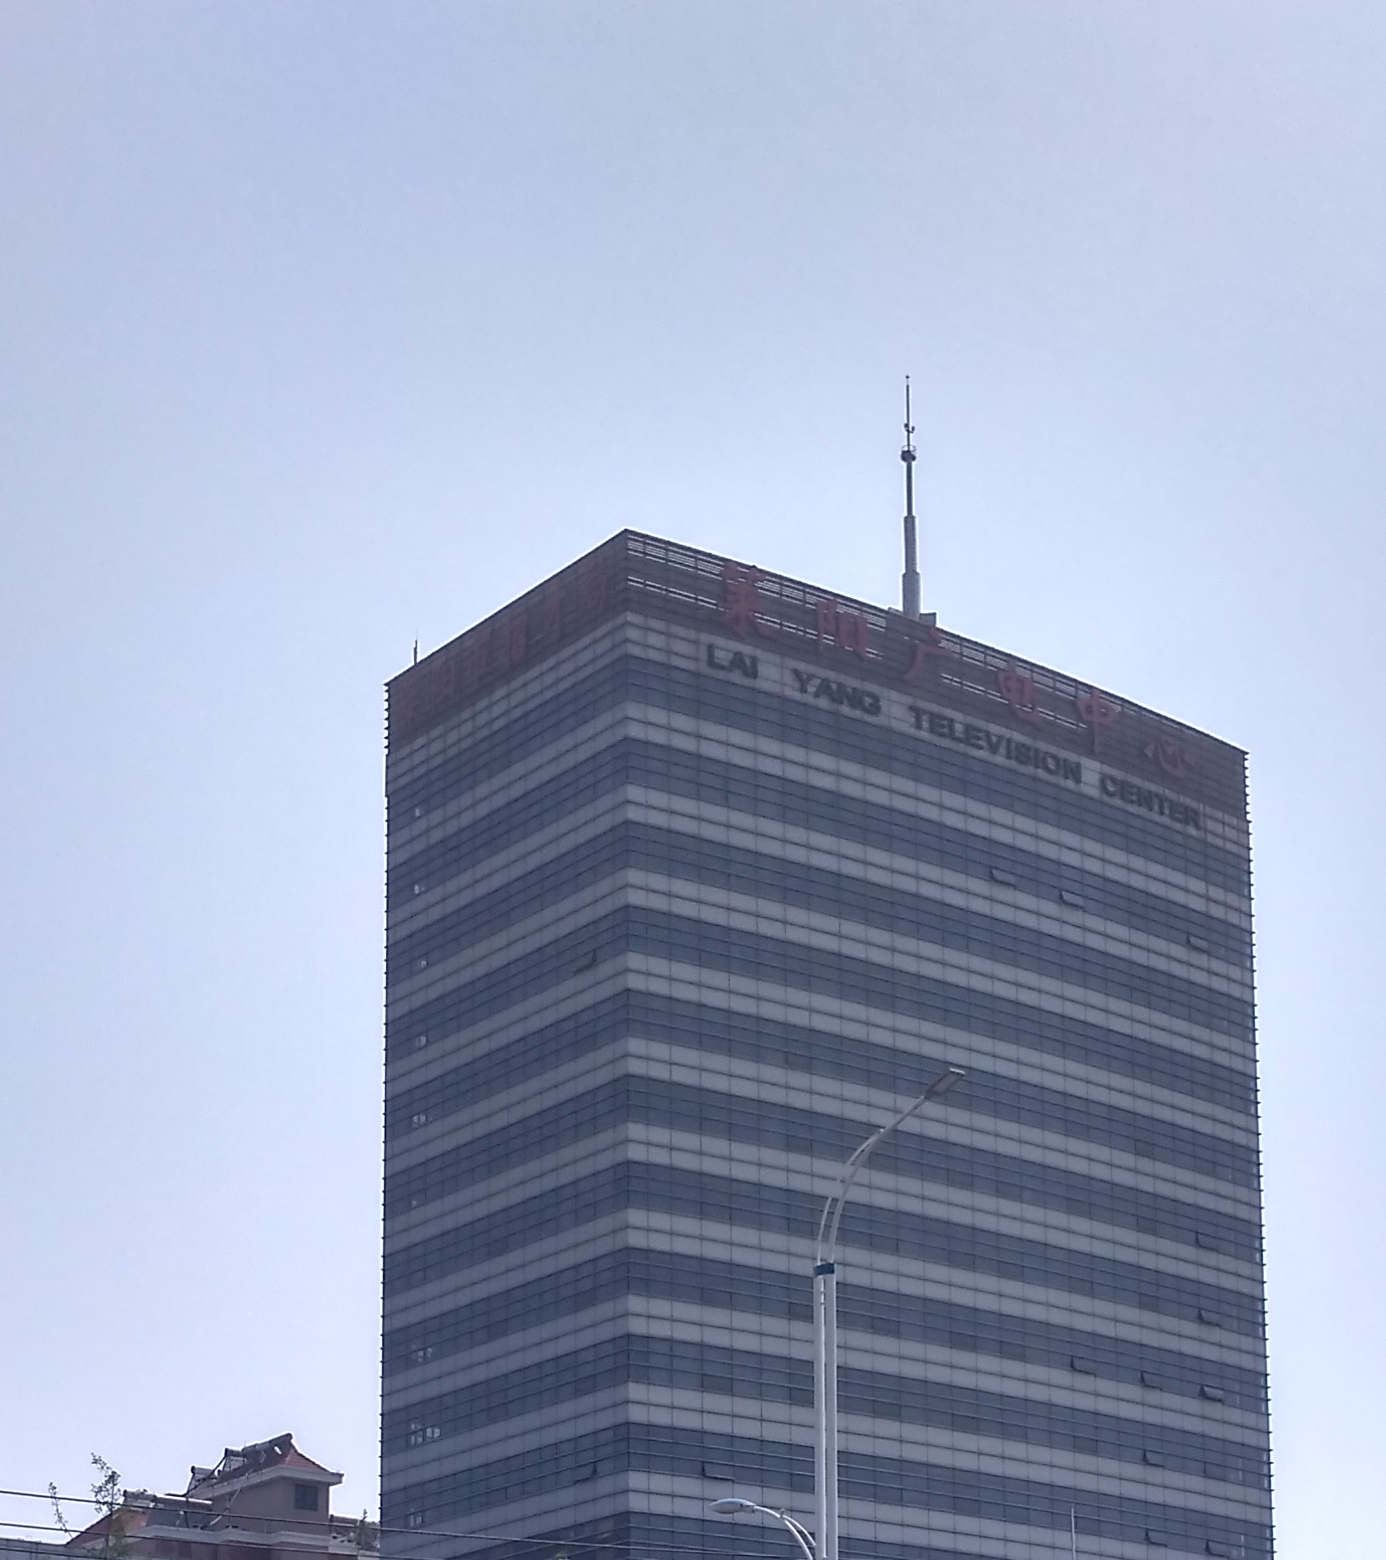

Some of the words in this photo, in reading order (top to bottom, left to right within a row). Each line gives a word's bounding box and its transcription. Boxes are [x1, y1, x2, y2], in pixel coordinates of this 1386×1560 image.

[706, 643, 759, 680] LAI
[792, 667, 883, 717] YANG
[908, 704, 1083, 785] TELEVISION
[1099, 773, 1203, 831] CENTER
[719, 561, 1197, 778] 莱阳广电中心
